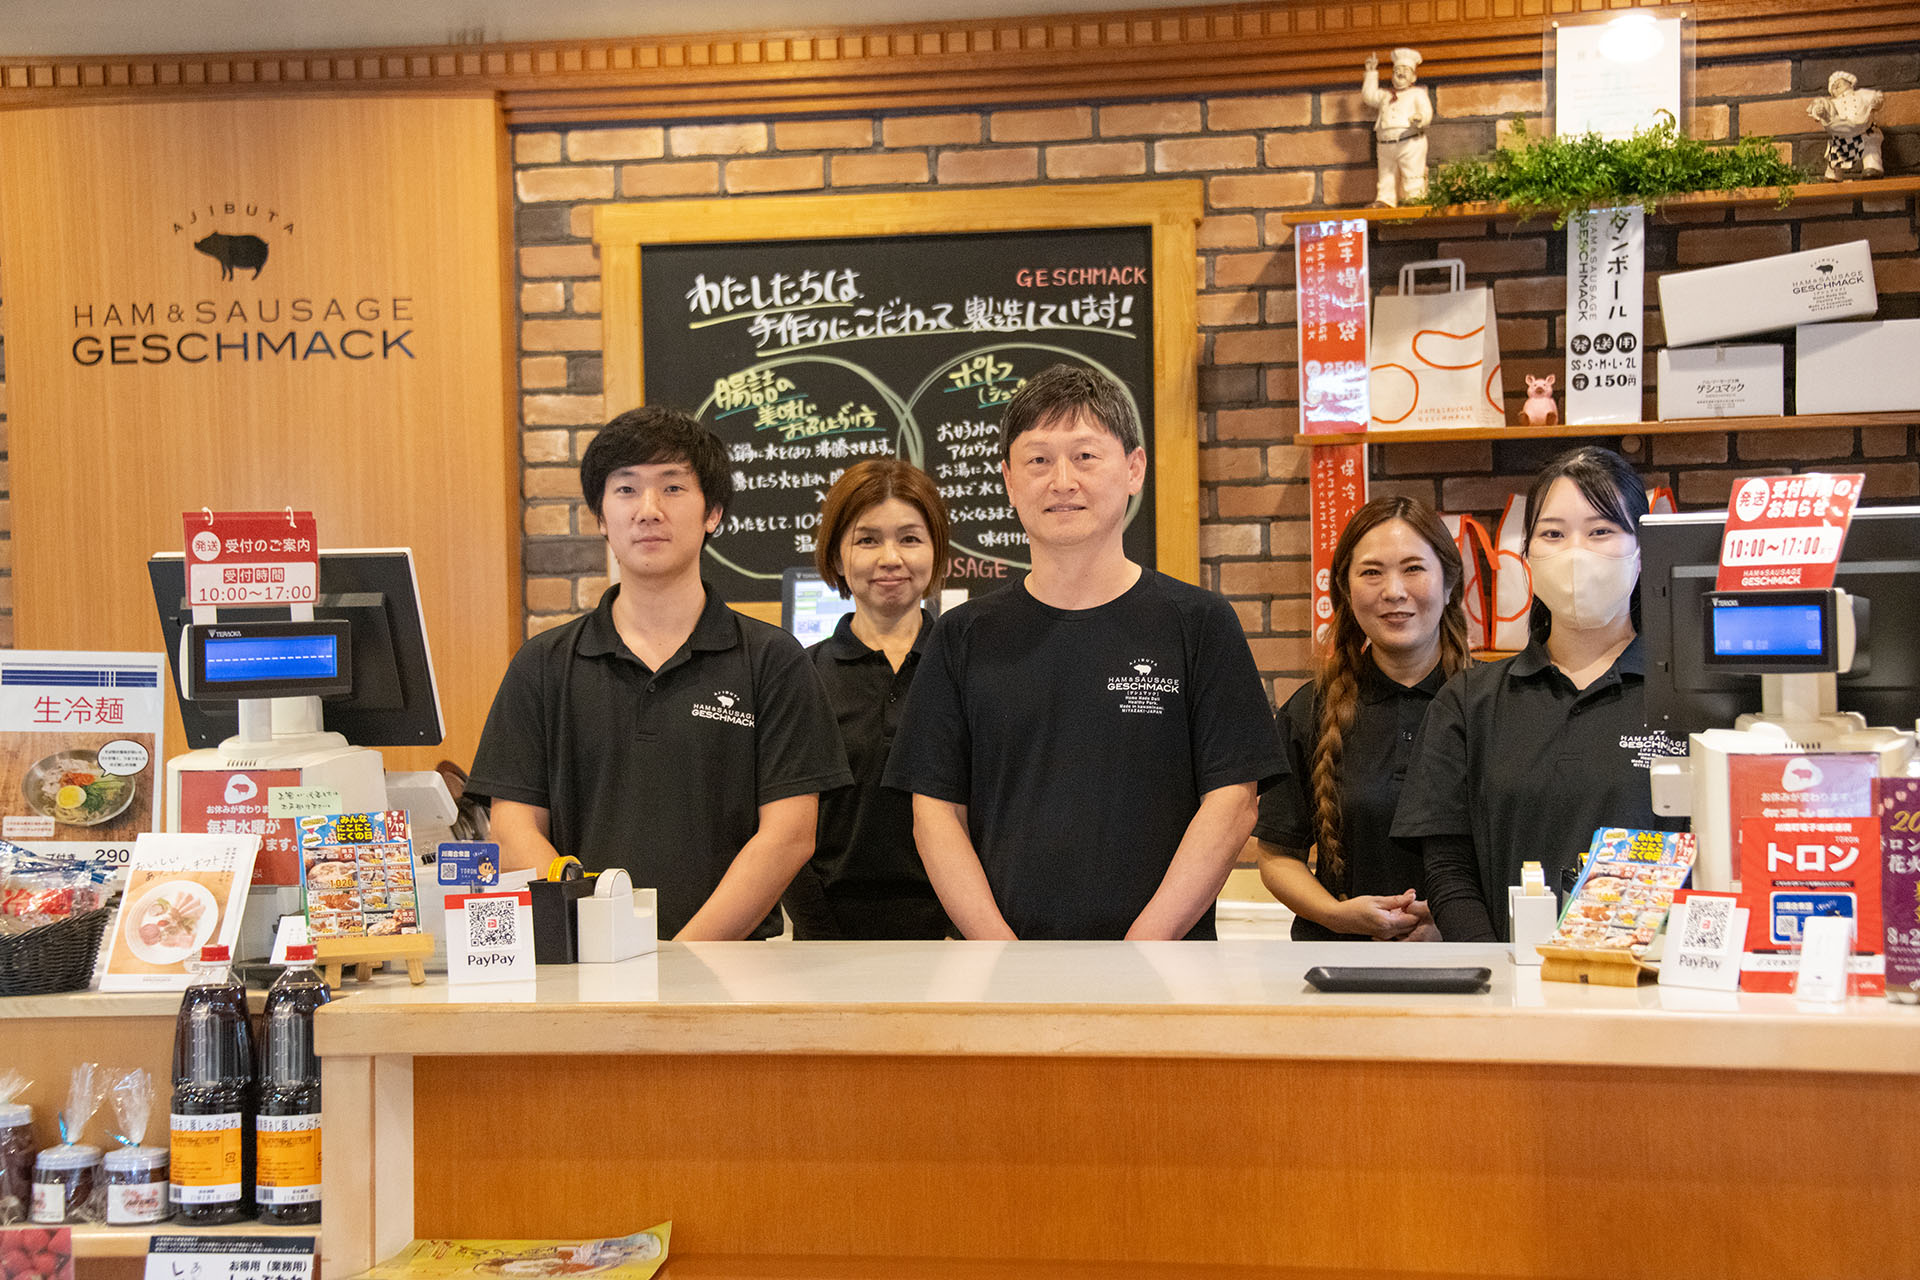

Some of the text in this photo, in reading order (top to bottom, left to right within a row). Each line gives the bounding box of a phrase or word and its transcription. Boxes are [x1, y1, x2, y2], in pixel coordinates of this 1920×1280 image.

[172, 202, 295, 236] AJIBUTA
[1015, 266, 1148, 288] GESCHMACK
[1792, 276, 1865, 295] GESCHMACK
[73, 298, 414, 329] HAM&SAUSAGE
[71, 330, 416, 366] GESCHMACK
[1571, 332, 1637, 356] 発送用
[946, 440, 1002, 461] アイスヴァイ
[1738, 490, 1767, 508] 発送
[1766, 498, 1830, 518] お知らせ
[194, 538, 311, 554] 発送 受付のご案内
[794, 532, 818, 554] 温
[224, 568, 285, 584] 受付時間
[1741, 575, 1801, 586] GESCHMACK
[1107, 682, 1180, 694] GESCHMACK
[1108, 676, 1179, 686] HAM&SAUSAGE
[33, 695, 125, 725] 生冷麺
[691, 708, 755, 728] GESCHMACK
[1620, 735, 1687, 748] HAM&SAUAGE
[206, 819, 281, 835] 毎週水曜が
[336, 822, 374, 833] にこにこ
[340, 813, 369, 824] みんな
[337, 831, 374, 841] にくの日
[95, 849, 130, 864] 290
[1767, 842, 1859, 872] トロン
[467, 953, 516, 968] PayPay
[1678, 954, 1721, 972] PayPay
